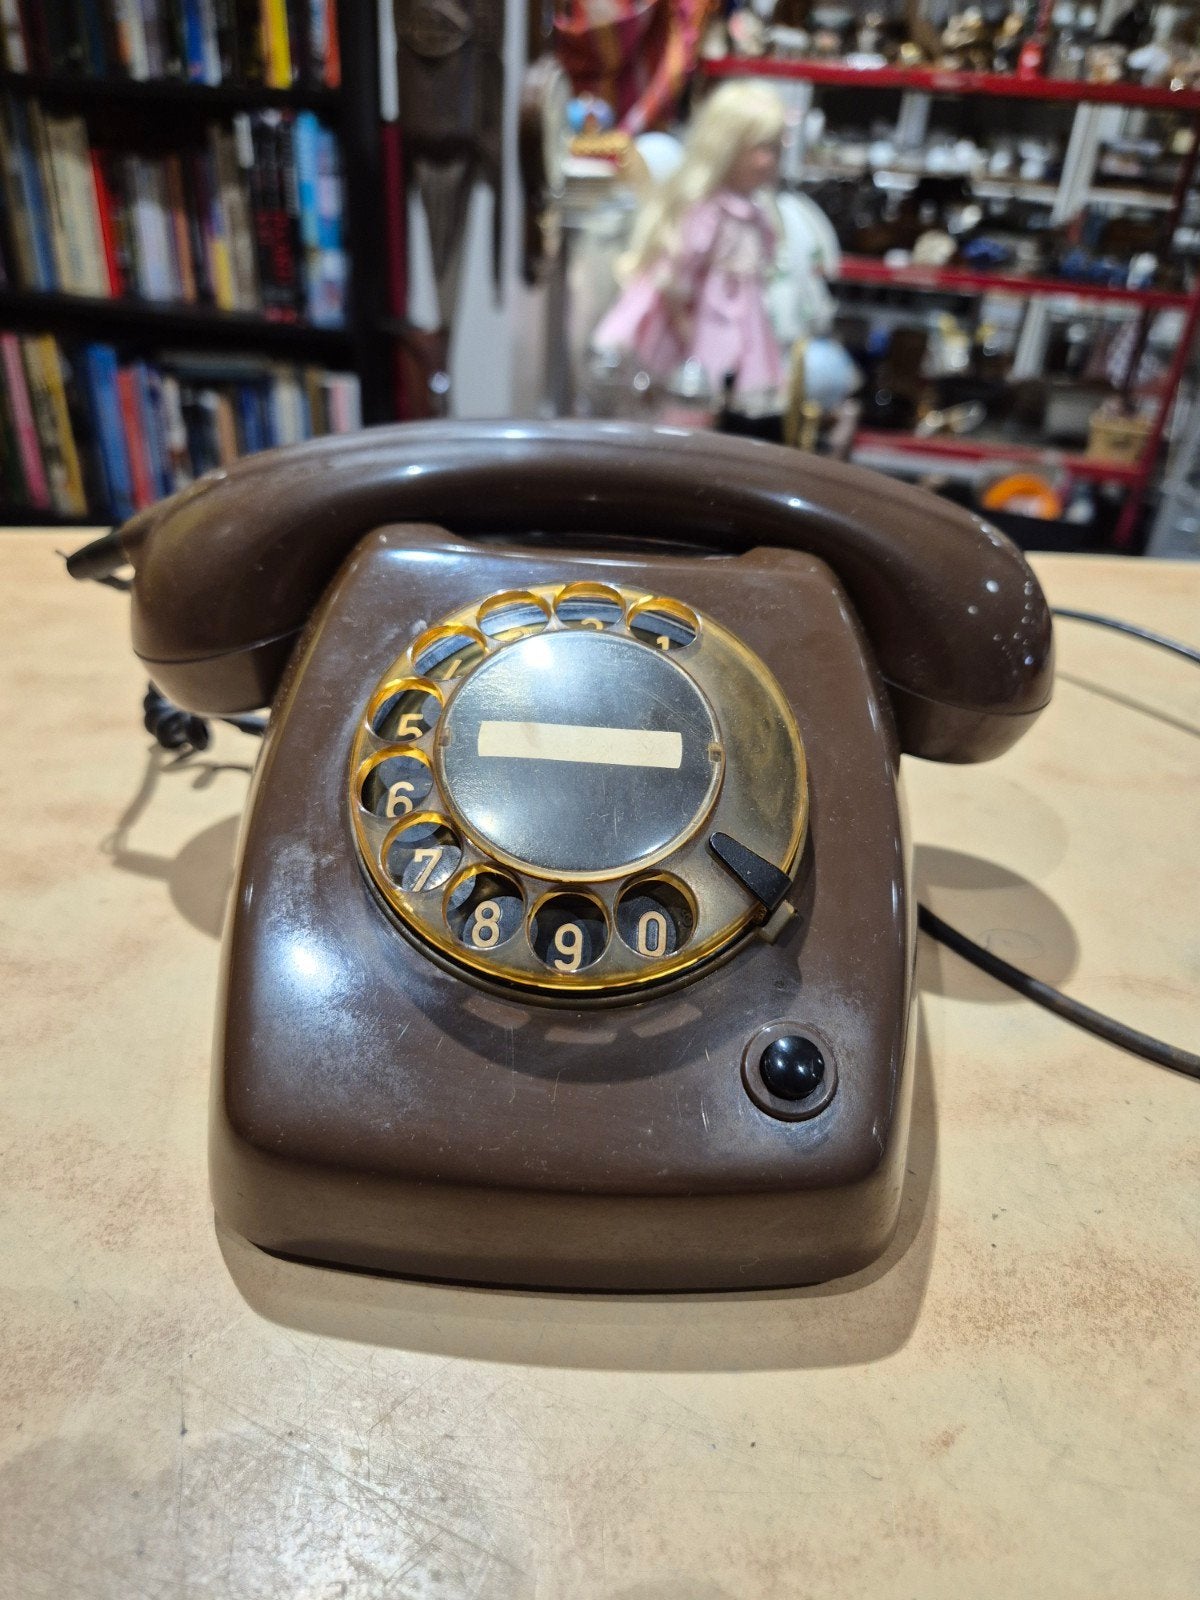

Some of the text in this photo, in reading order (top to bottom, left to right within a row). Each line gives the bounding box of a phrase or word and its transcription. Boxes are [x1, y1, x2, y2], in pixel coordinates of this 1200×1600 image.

[397, 713, 424, 738] 5
[386, 781, 415, 818] 6
[411, 848, 443, 892] 7
[471, 900, 501, 948] 8
[638, 910, 667, 957] 0
[554, 923, 583, 972] 9
